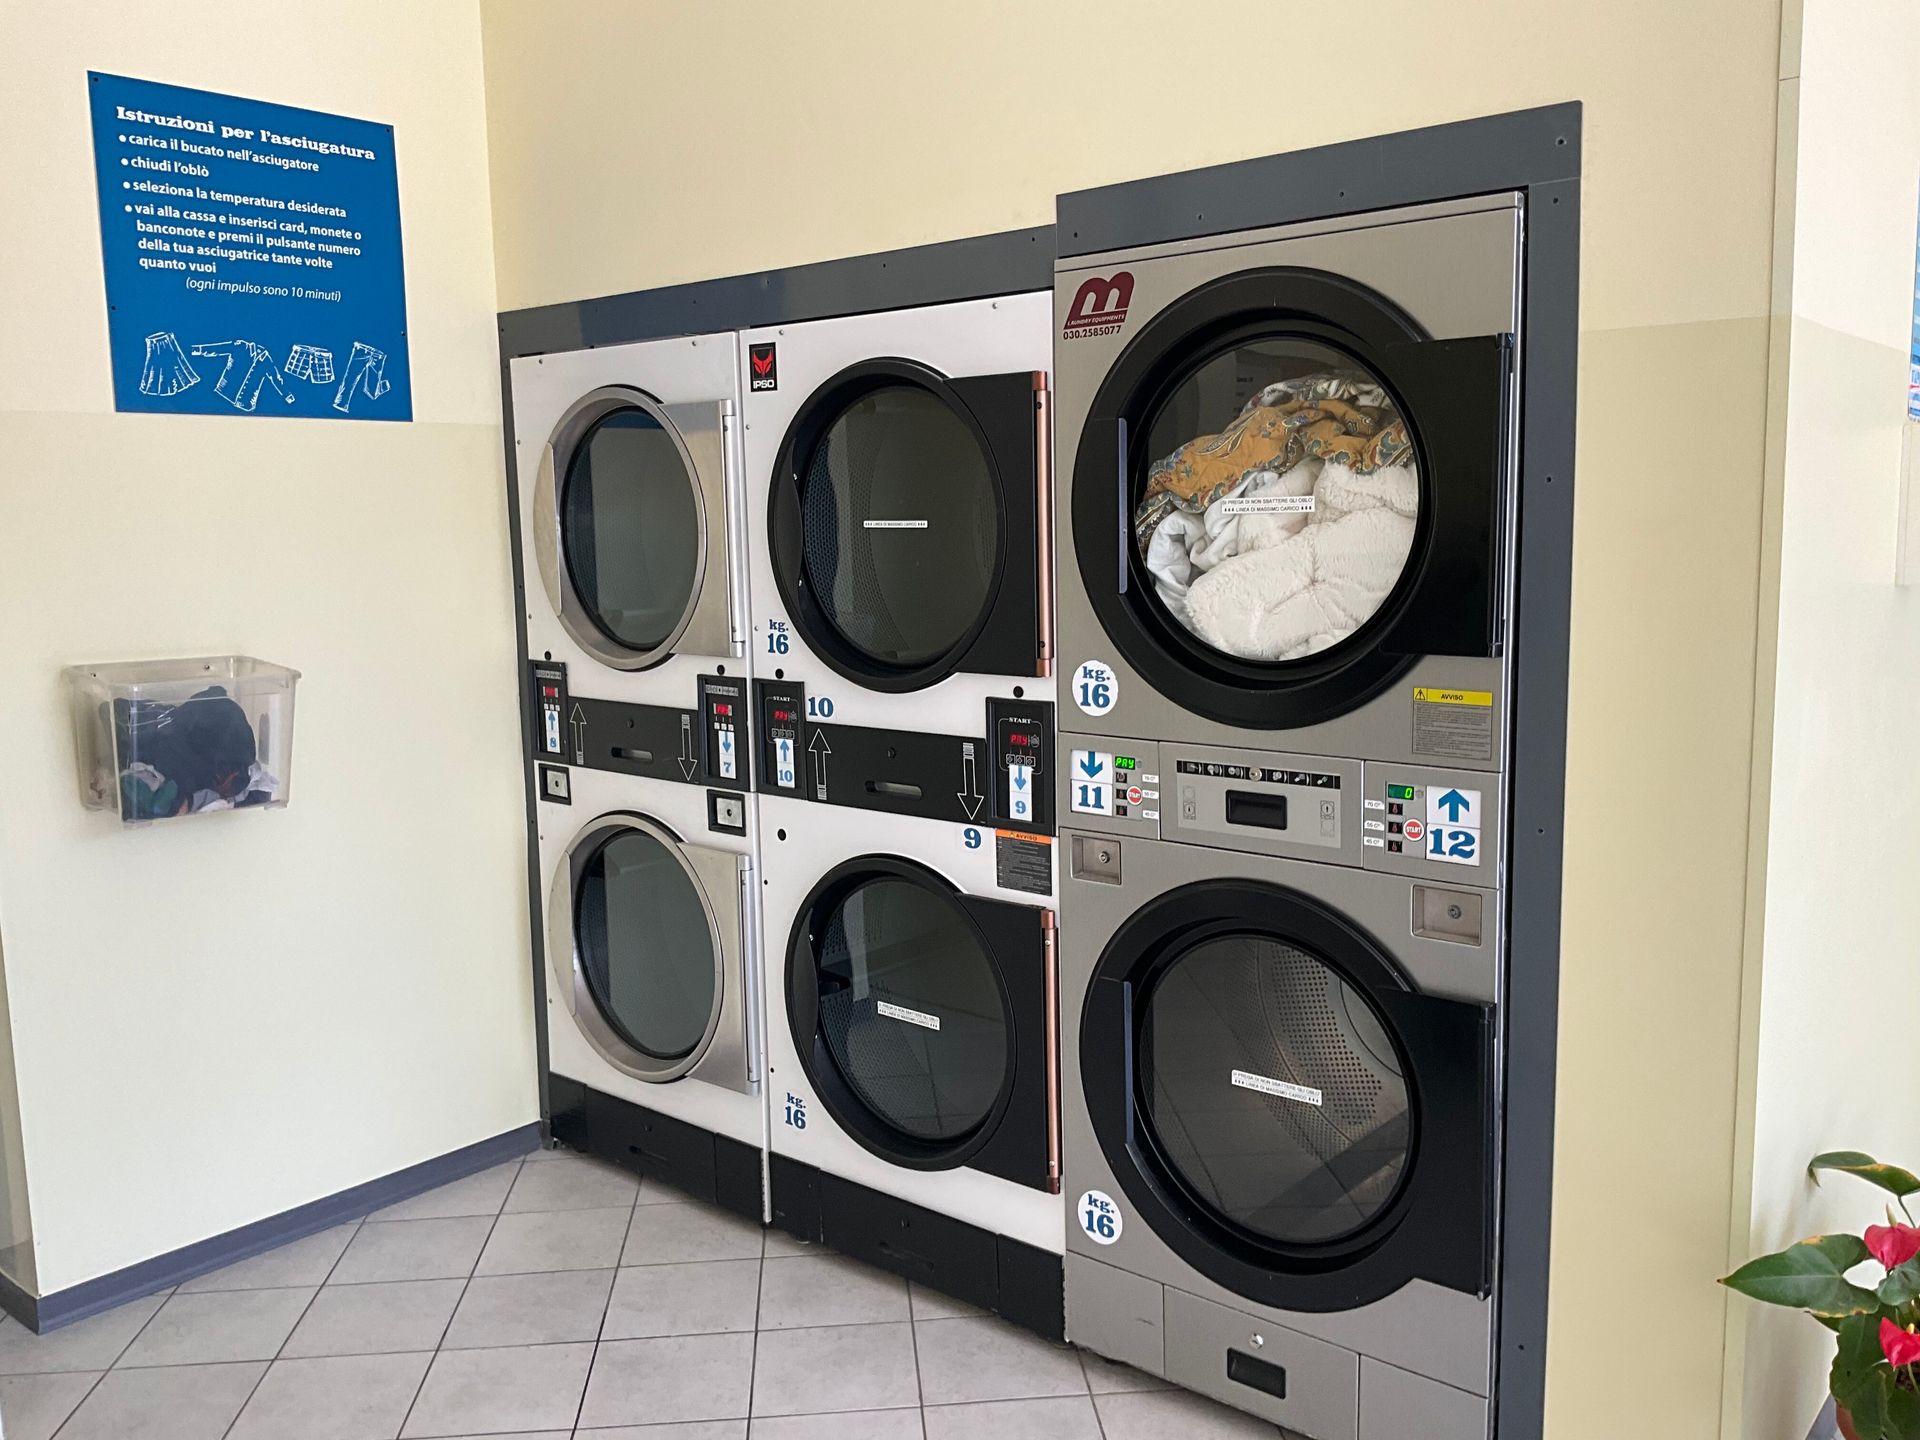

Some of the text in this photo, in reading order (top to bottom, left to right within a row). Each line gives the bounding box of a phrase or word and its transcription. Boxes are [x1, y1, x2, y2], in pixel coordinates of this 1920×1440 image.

[116, 106, 375, 160] Istruzioni per l'asciugatura
[129, 135, 319, 171] carica il bucato nell'asciugatore
[131, 156, 209, 177] chiudi l'oblò
[133, 180, 346, 217] seleziona la temperatura desiderata
[134, 204, 361, 240] vai alla cassa e inserisci card, monete o
[137, 219, 361, 256] banconote e premi il pulsante numero
[138, 237, 333, 268] della tua asciugatrice tante volte
[139, 258, 216, 273] quanto vuoi
[186, 277, 341, 302] (ogni impulso sono 10 minuti)
[1063, 325, 1122, 340] 030.2585077
[753, 379, 775, 389] IPSO
[769, 619, 789, 632] kg.
[768, 633, 789, 654] 16
[1082, 666, 1110, 682] kg.
[1080, 682, 1110, 708] 16
[808, 696, 834, 718] 10
[1008, 716, 1032, 725] START
[550, 736, 557, 748] 8
[723, 761, 732, 773] 7
[1115, 757, 1135, 769] PAY
[779, 769, 793, 782] 10
[1078, 785, 1104, 809] 11
[1404, 787, 1413, 799] 0
[1015, 800, 1026, 814] 9
[963, 827, 982, 849] 9
[1016, 833, 1038, 841] AVVISO
[1406, 826, 1421, 834] START
[1429, 828, 1476, 859] 12
[787, 1092, 806, 1109] kg.
[785, 1105, 806, 1129] 16
[1088, 1193, 1115, 1214] kg.
[1085, 1210, 1114, 1238] 16
